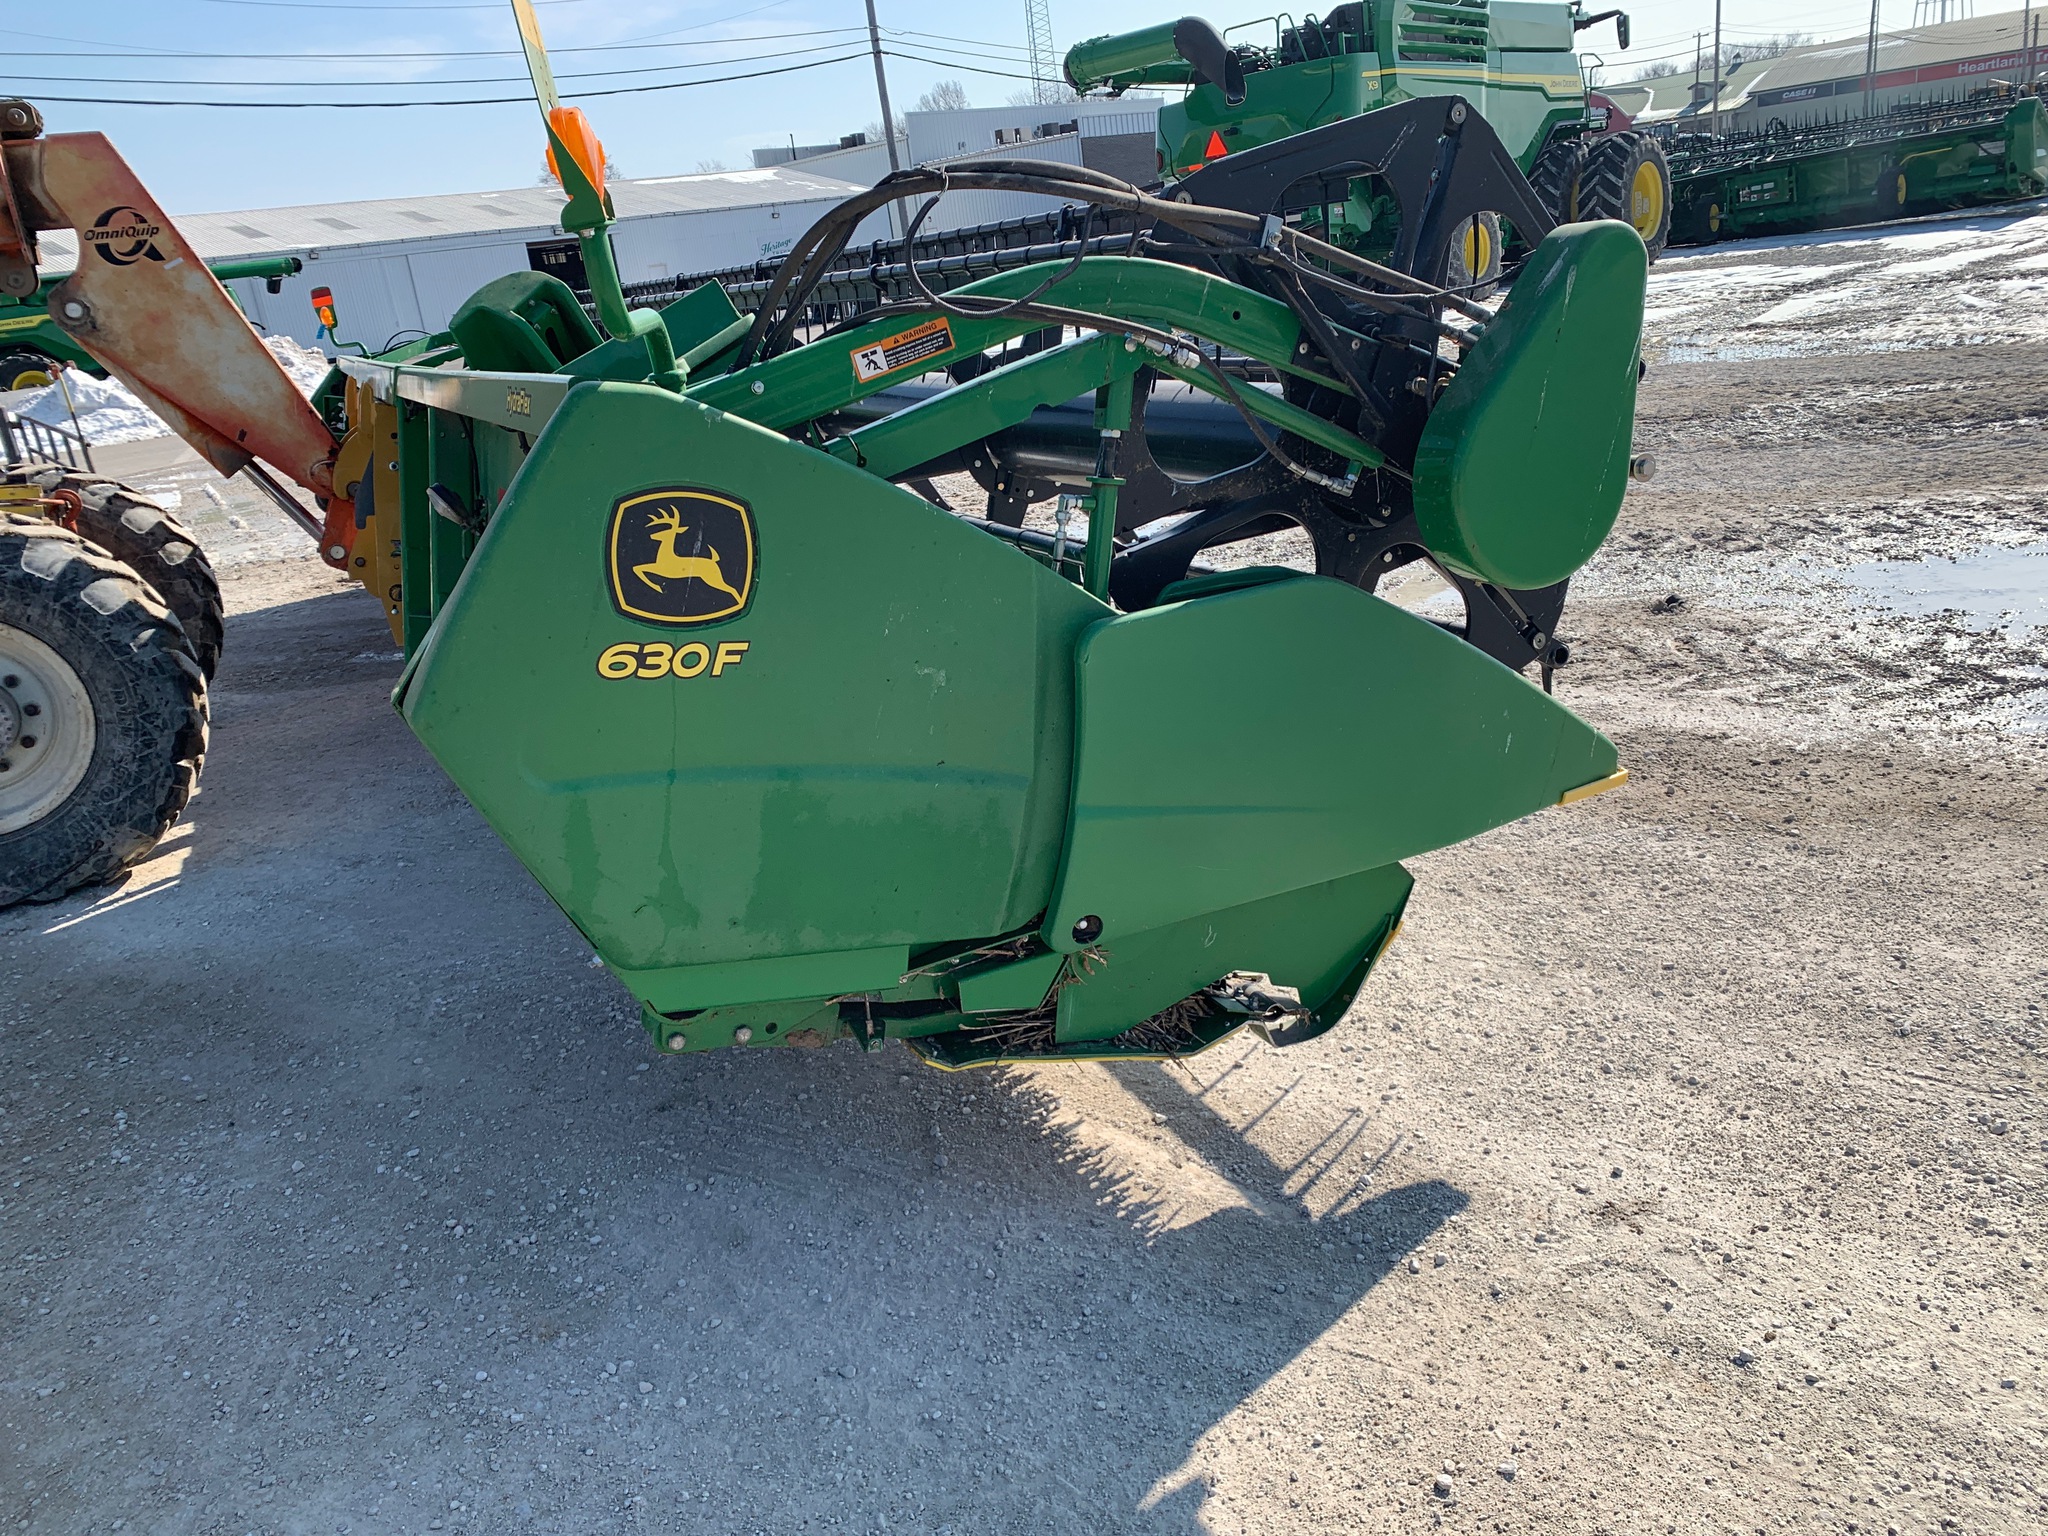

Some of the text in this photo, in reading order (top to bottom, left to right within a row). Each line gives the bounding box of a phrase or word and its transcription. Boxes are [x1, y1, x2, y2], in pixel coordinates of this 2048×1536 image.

[1957, 52, 2029, 74] Heartland
[1366, 80, 1379, 91] X9
[1782, 89, 1808, 98] CASE
[83, 224, 160, 241] OmniQuip
[761, 238, 792, 256] Heritage
[901, 322, 938, 341] WARNING
[596, 640, 751, 681] 630F
